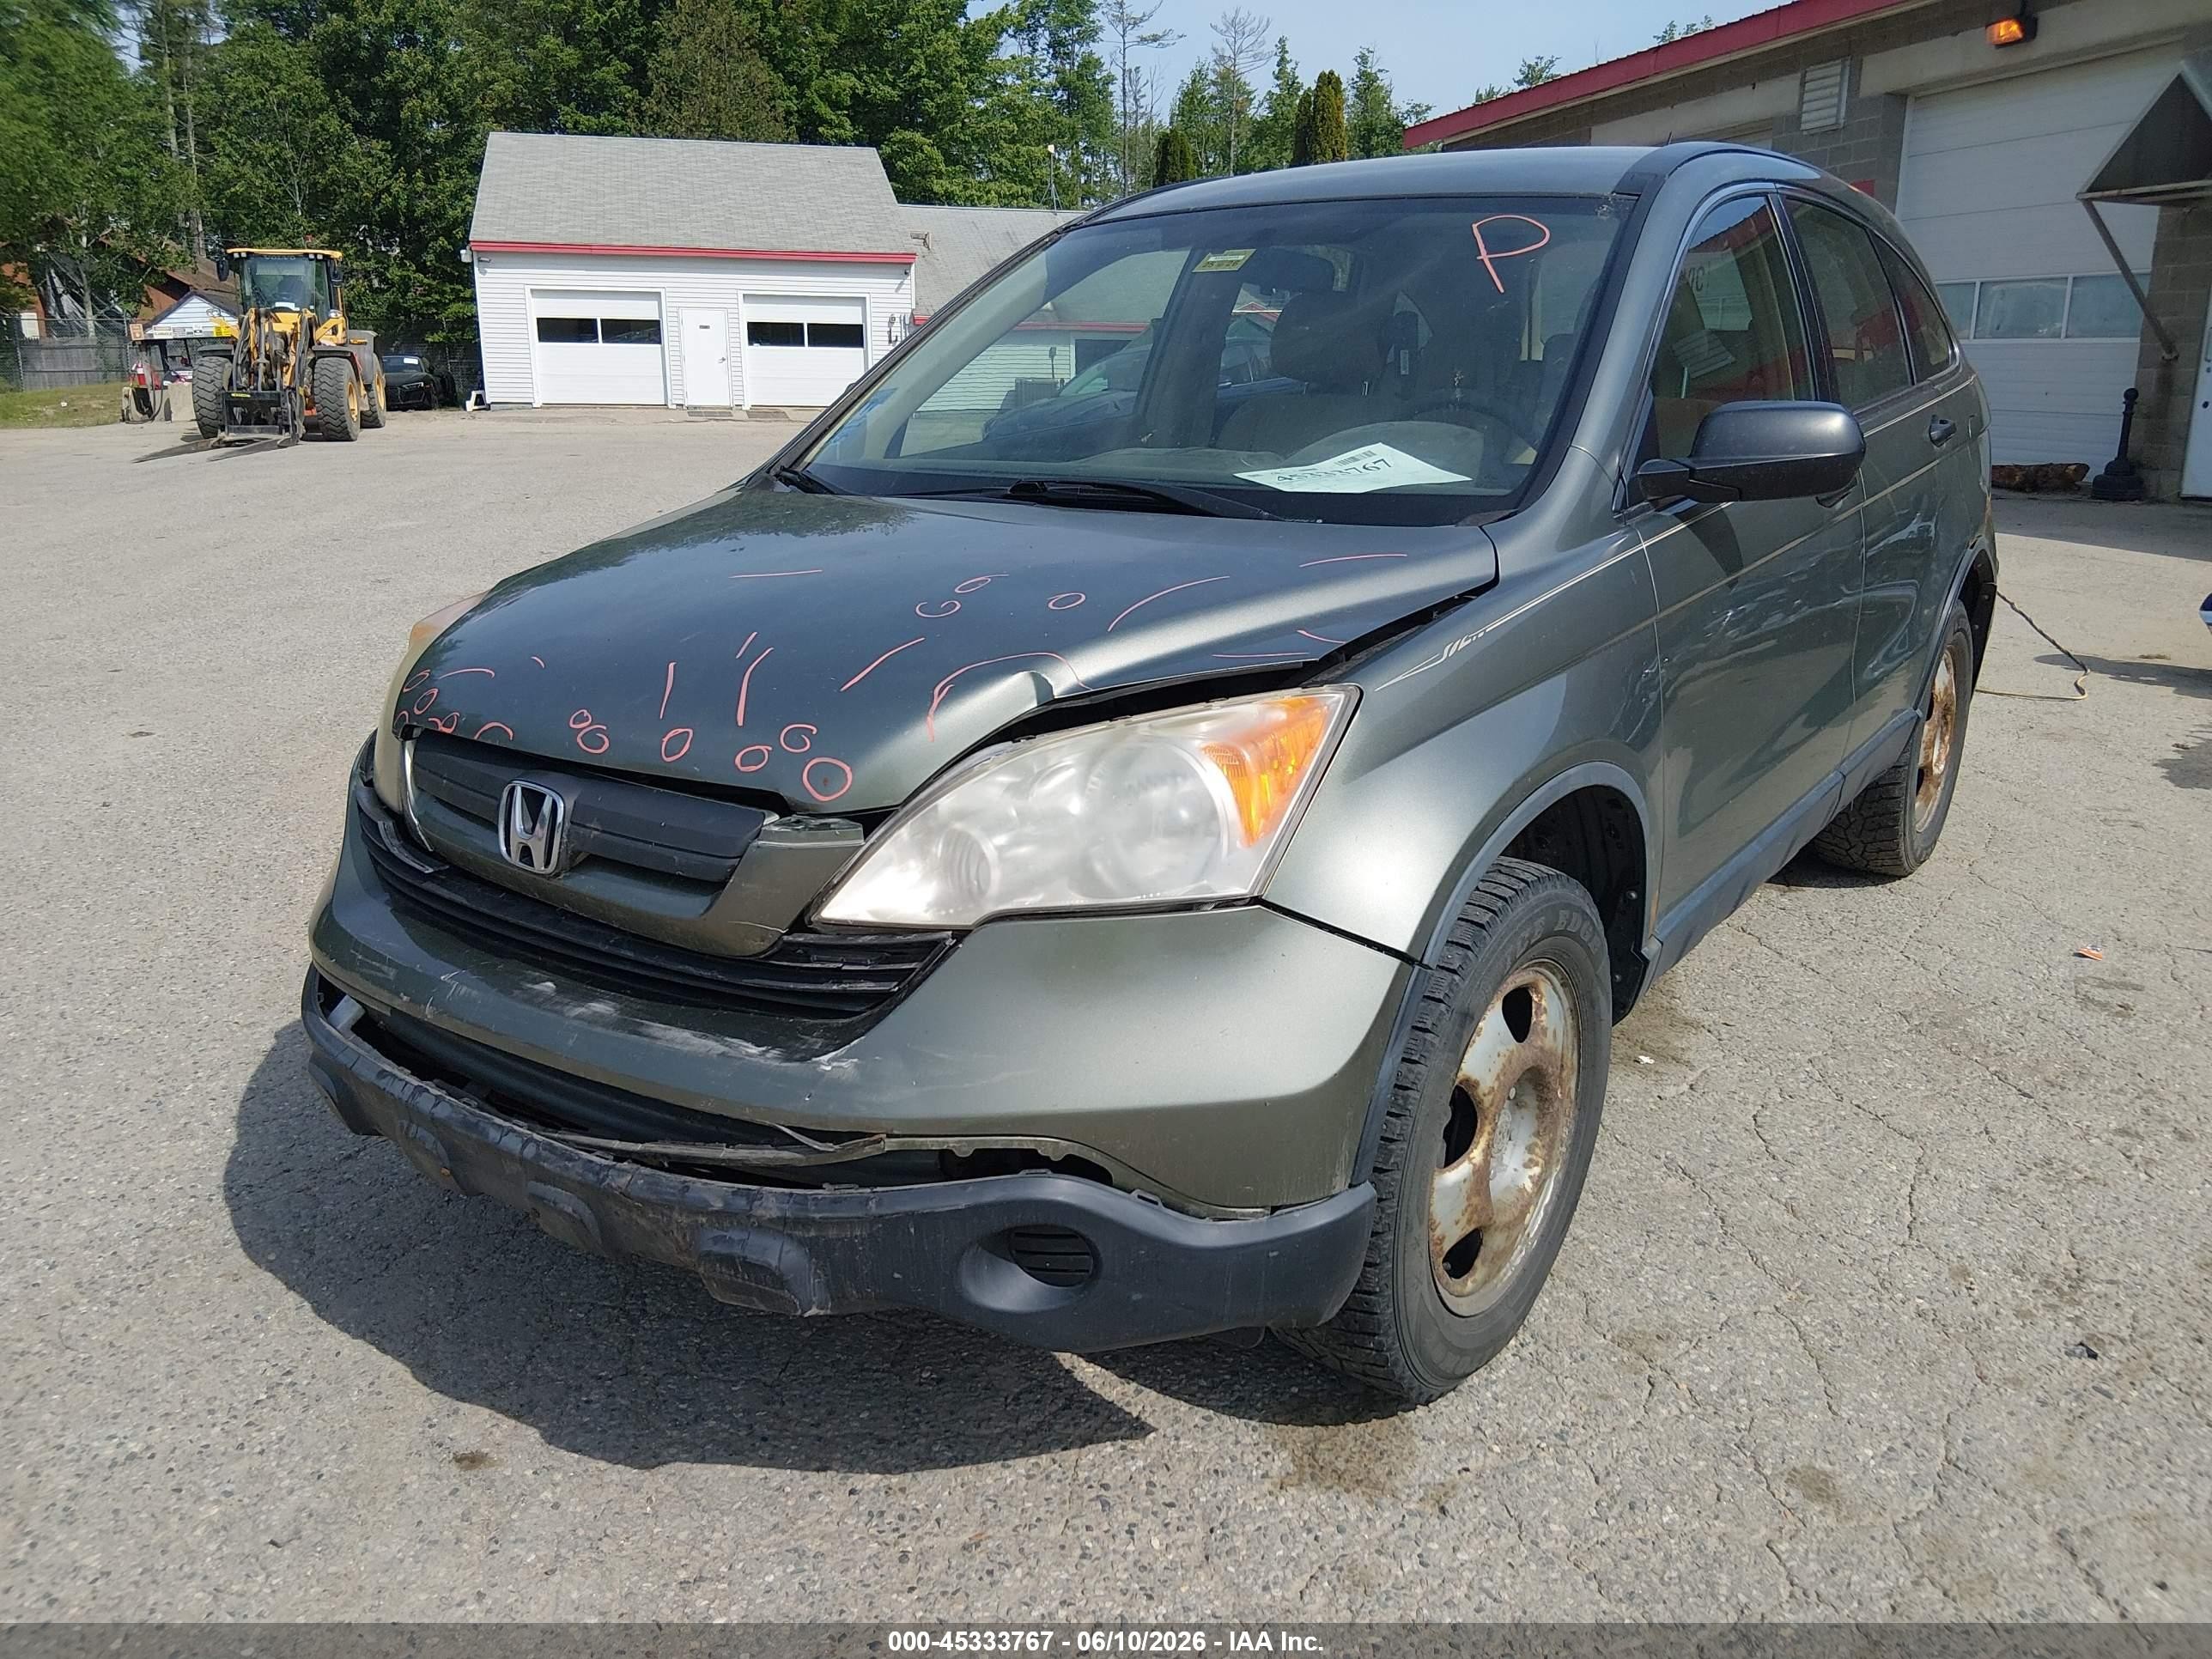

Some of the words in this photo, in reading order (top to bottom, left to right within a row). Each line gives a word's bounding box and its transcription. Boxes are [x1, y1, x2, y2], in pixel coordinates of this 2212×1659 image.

[1471, 214, 1551, 294] P
[1276, 458, 1393, 482] 45333767
[1553, 908, 1601, 955] EDGE
